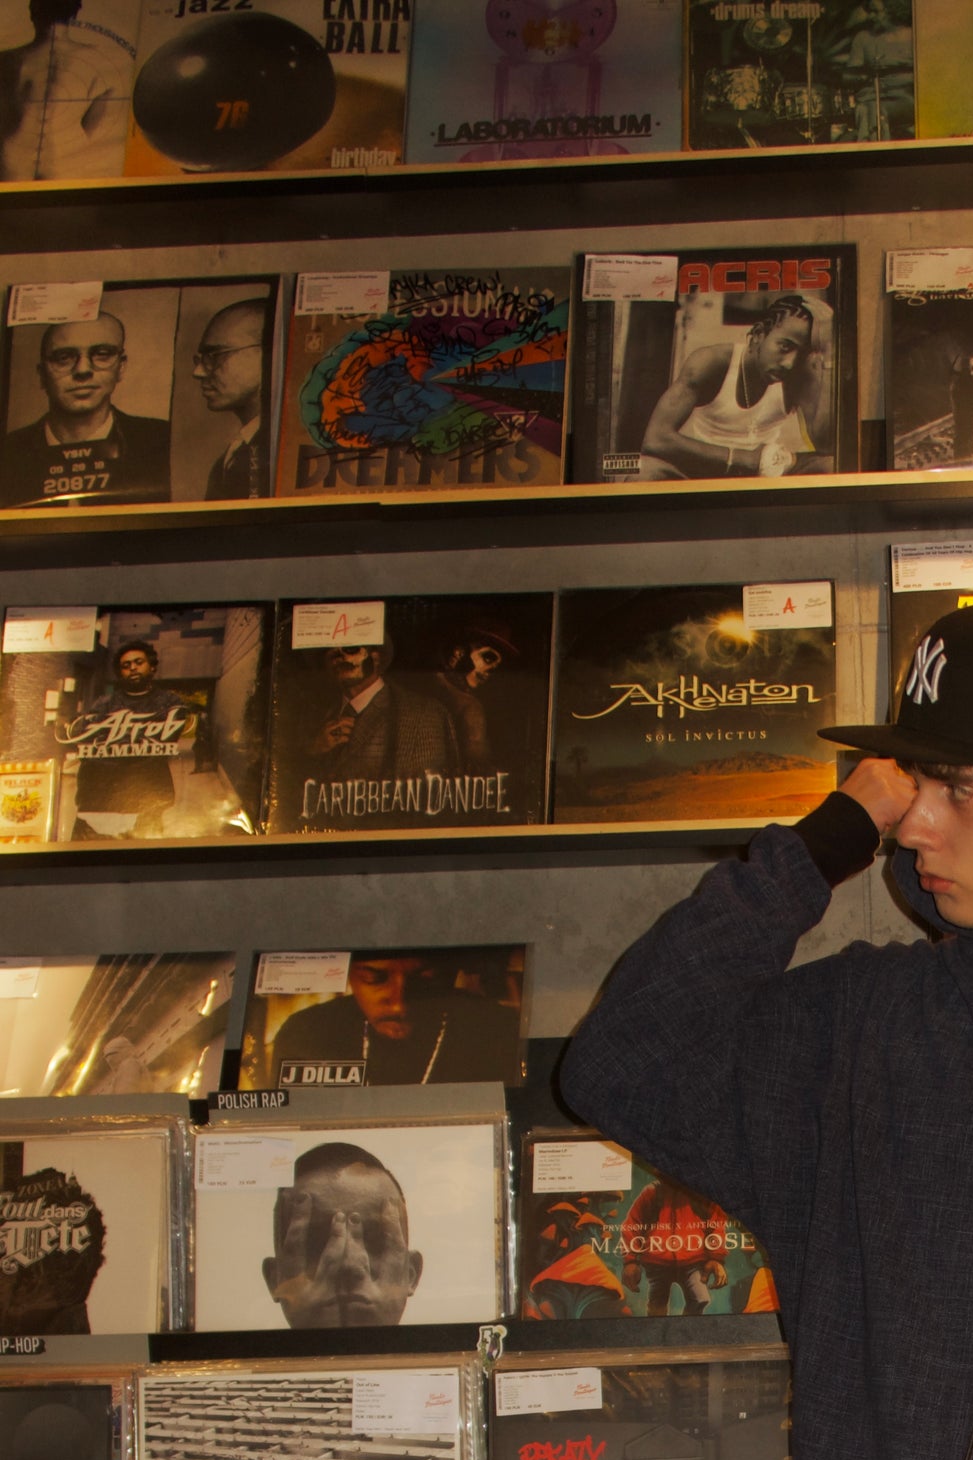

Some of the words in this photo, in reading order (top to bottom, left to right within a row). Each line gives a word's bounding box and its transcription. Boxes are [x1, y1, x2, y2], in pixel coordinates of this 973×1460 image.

[715, 2, 764, 19] drums
[325, 22, 400, 53] BALL
[438, 113, 651, 142] LABORATORIUM
[331, 146, 398, 168] birthday
[43, 472, 110, 495] 20877
[783, 597, 798, 614] A
[332, 613, 351, 640] A
[645, 732, 675, 743] SOL
[685, 728, 768, 742] INVICTUS
[78, 742, 180, 759] HAMMER
[302, 778, 422, 820] CARIBBEAN
[425, 769, 510, 816] DANDEE
[282, 1066, 297, 1083] J
[301, 1066, 361, 1083] DILLA
[218, 1093, 258, 1109] POLISH
[261, 1091, 285, 1107] RAP
[591, 1232, 757, 1256] MACRODOSE
